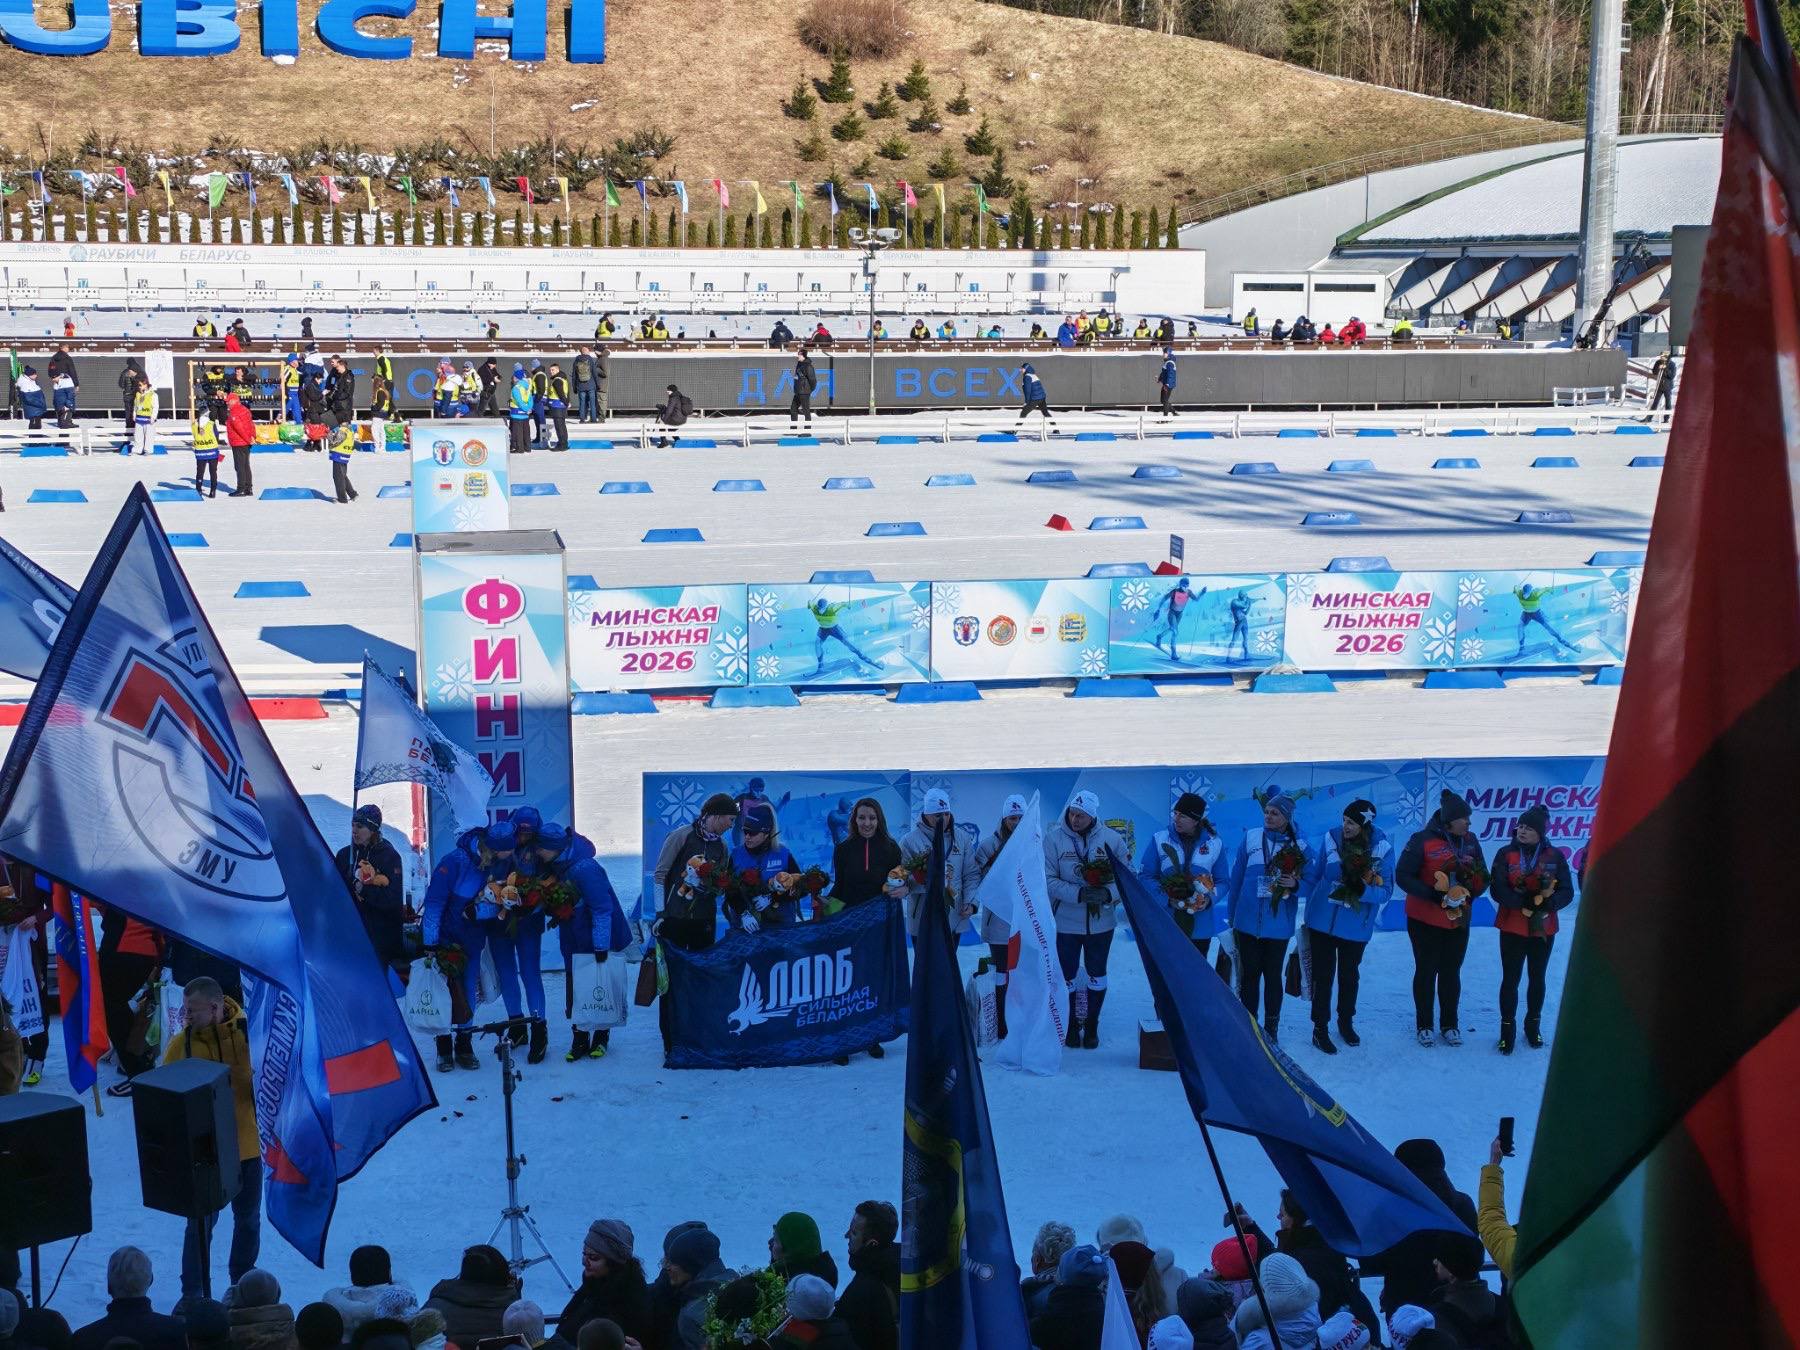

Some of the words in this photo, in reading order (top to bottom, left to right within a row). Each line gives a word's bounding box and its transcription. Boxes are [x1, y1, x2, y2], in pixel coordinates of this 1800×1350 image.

[89, 247, 157, 260] РАУБИЧИ
[179, 249, 251, 261] БЕЛАРУСЬ
[737, 368, 835, 405] ДЛЯ
[895, 367, 1022, 399] ВСЕХ
[1312, 592, 1431, 608] МИНСКАЯ
[590, 606, 719, 627] МИНСКАЯ
[1323, 612, 1422, 629] ЛЫЖНЯ
[605, 627, 710, 648] ЛЫЖНЯ
[1335, 634, 1405, 653] 2026
[620, 650, 695, 672] 2026
[1464, 786, 1601, 809] МИНСК
[765, 947, 854, 1010] ЛДПБ
[797, 986, 870, 1016] СИЛЬНАЯ
[796, 997, 879, 1028] БЕЛАРУСЬ!
